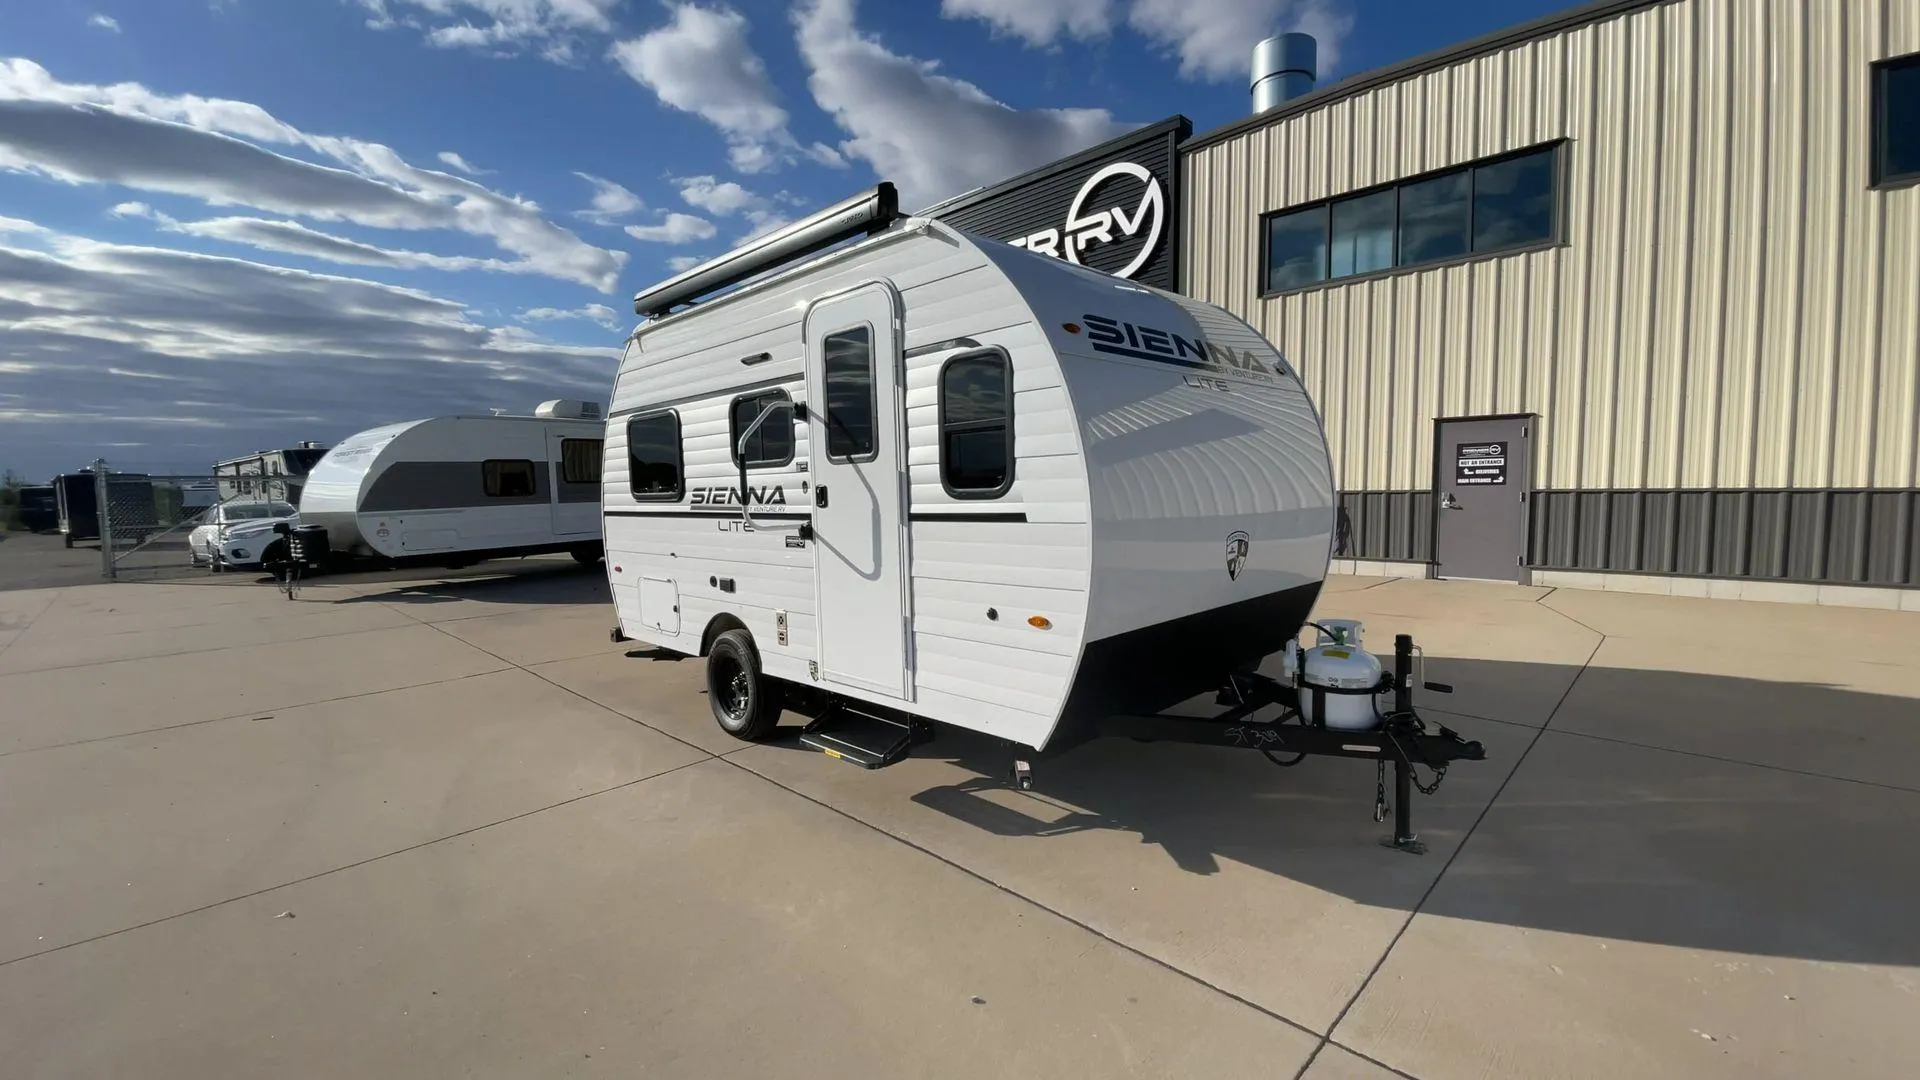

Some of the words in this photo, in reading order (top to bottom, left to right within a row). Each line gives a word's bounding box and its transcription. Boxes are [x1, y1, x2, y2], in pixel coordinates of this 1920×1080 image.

[1082, 313, 1270, 374] SIENNA
[1182, 374, 1230, 393] LITE
[690, 485, 787, 505] SIENNA
[718, 520, 755, 533] LITE
